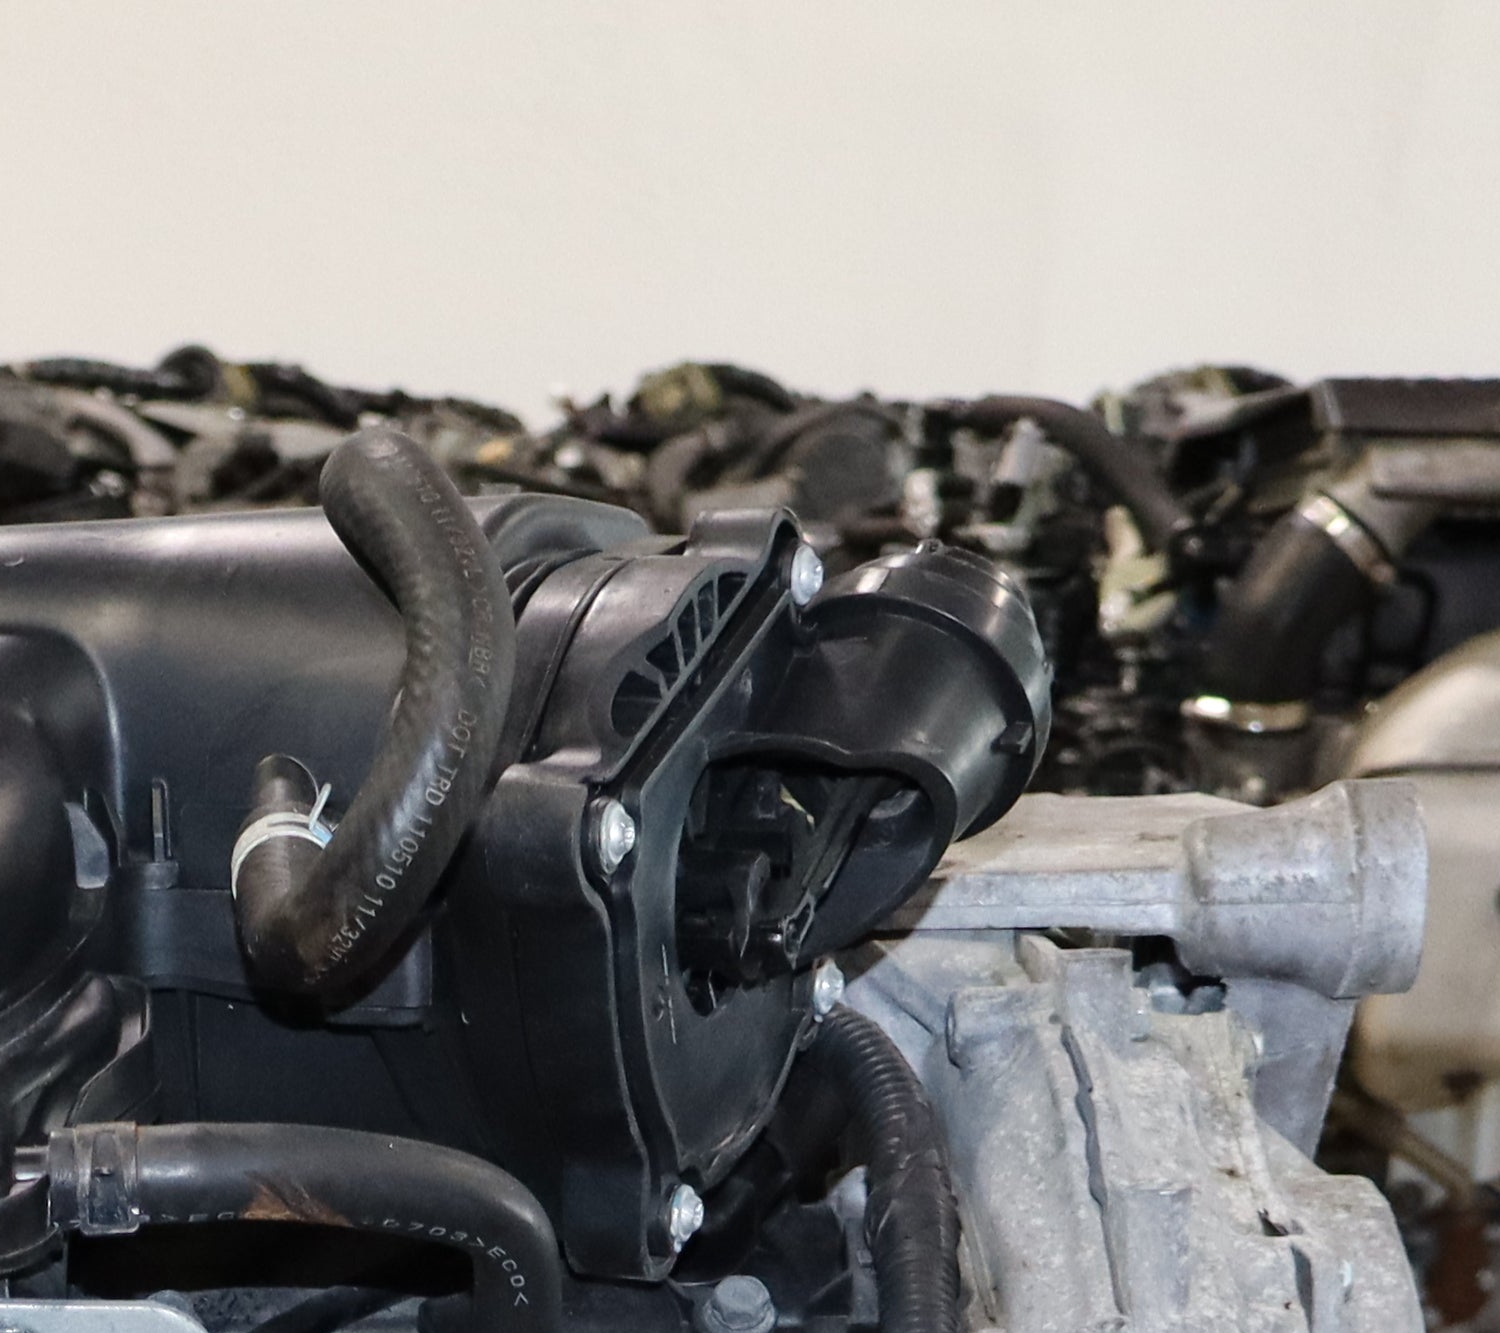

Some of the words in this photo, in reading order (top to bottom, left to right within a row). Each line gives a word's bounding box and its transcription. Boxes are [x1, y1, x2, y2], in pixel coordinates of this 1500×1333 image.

[449, 708, 478, 760] DOT
[424, 763, 459, 807] TRD
[374, 814, 433, 891] 110510
